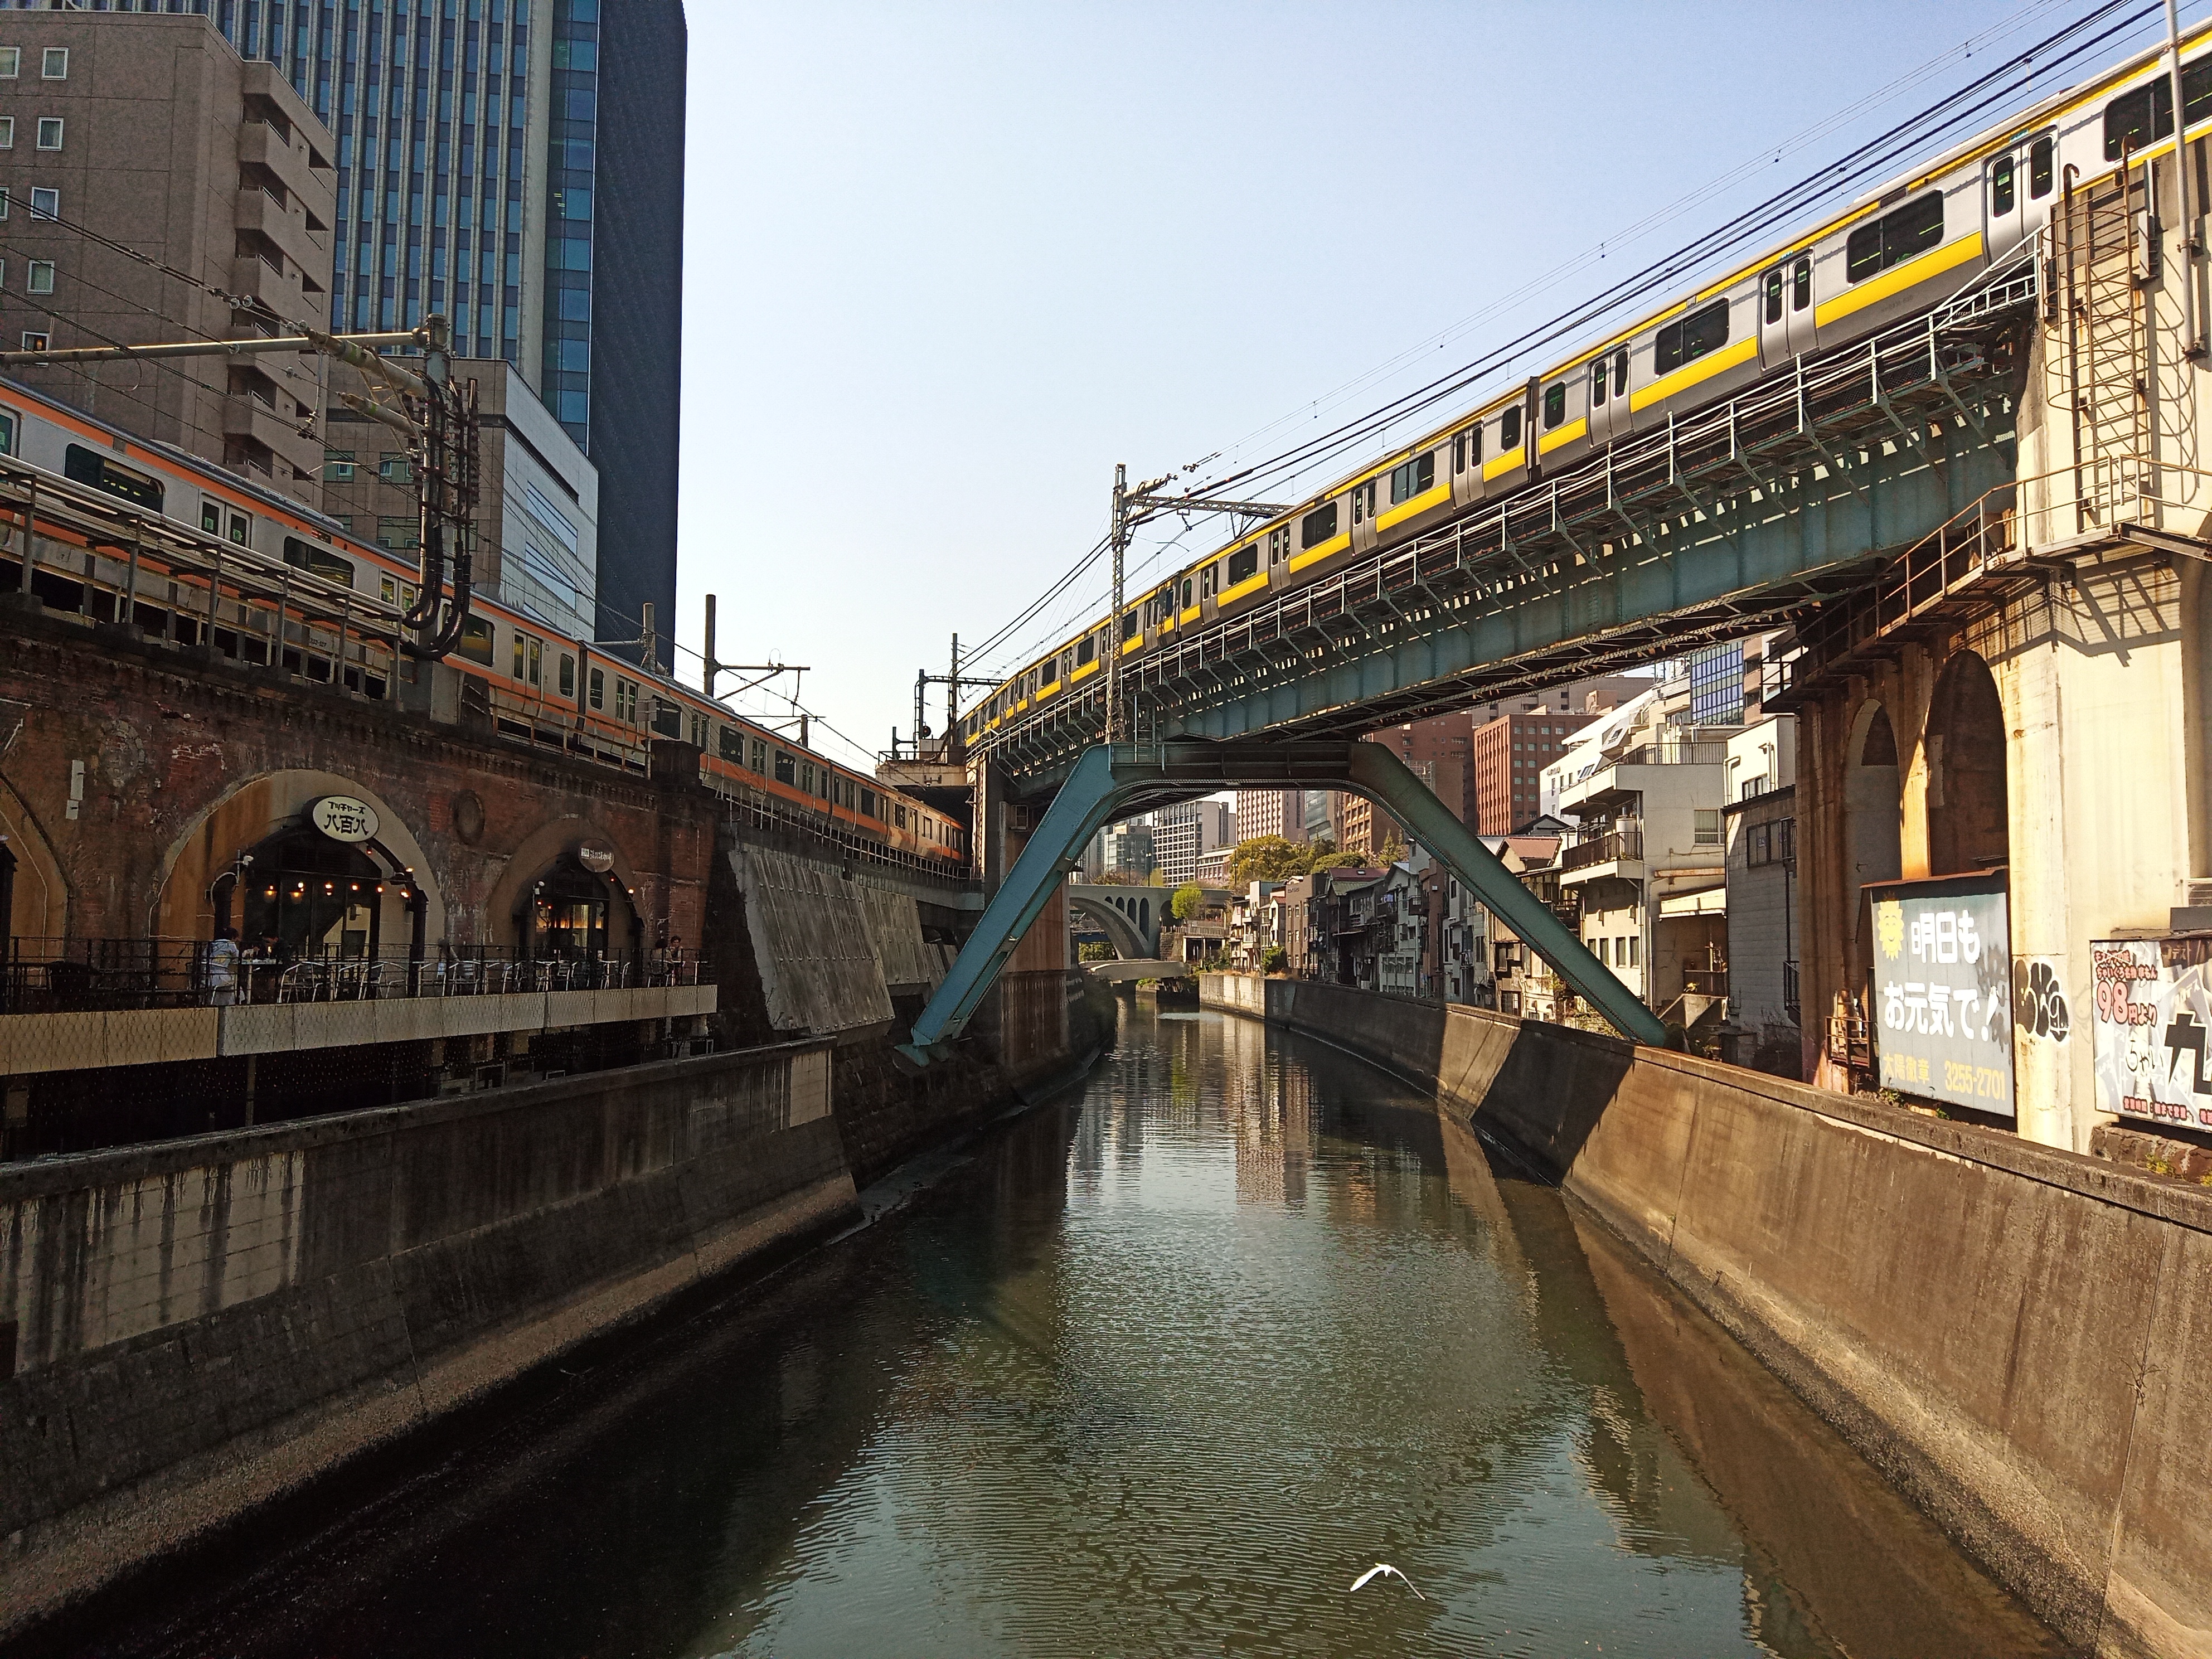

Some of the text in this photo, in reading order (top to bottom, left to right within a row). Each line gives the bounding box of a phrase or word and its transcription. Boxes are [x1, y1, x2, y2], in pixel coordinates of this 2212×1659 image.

[324, 813, 368, 836] 八百八
[1910, 910, 1981, 964] 明日も
[1884, 981, 2000, 1042] お元気で！
[2097, 980, 2158, 1028] 98円より
[1944, 1060, 2006, 1102] 3255-2701
